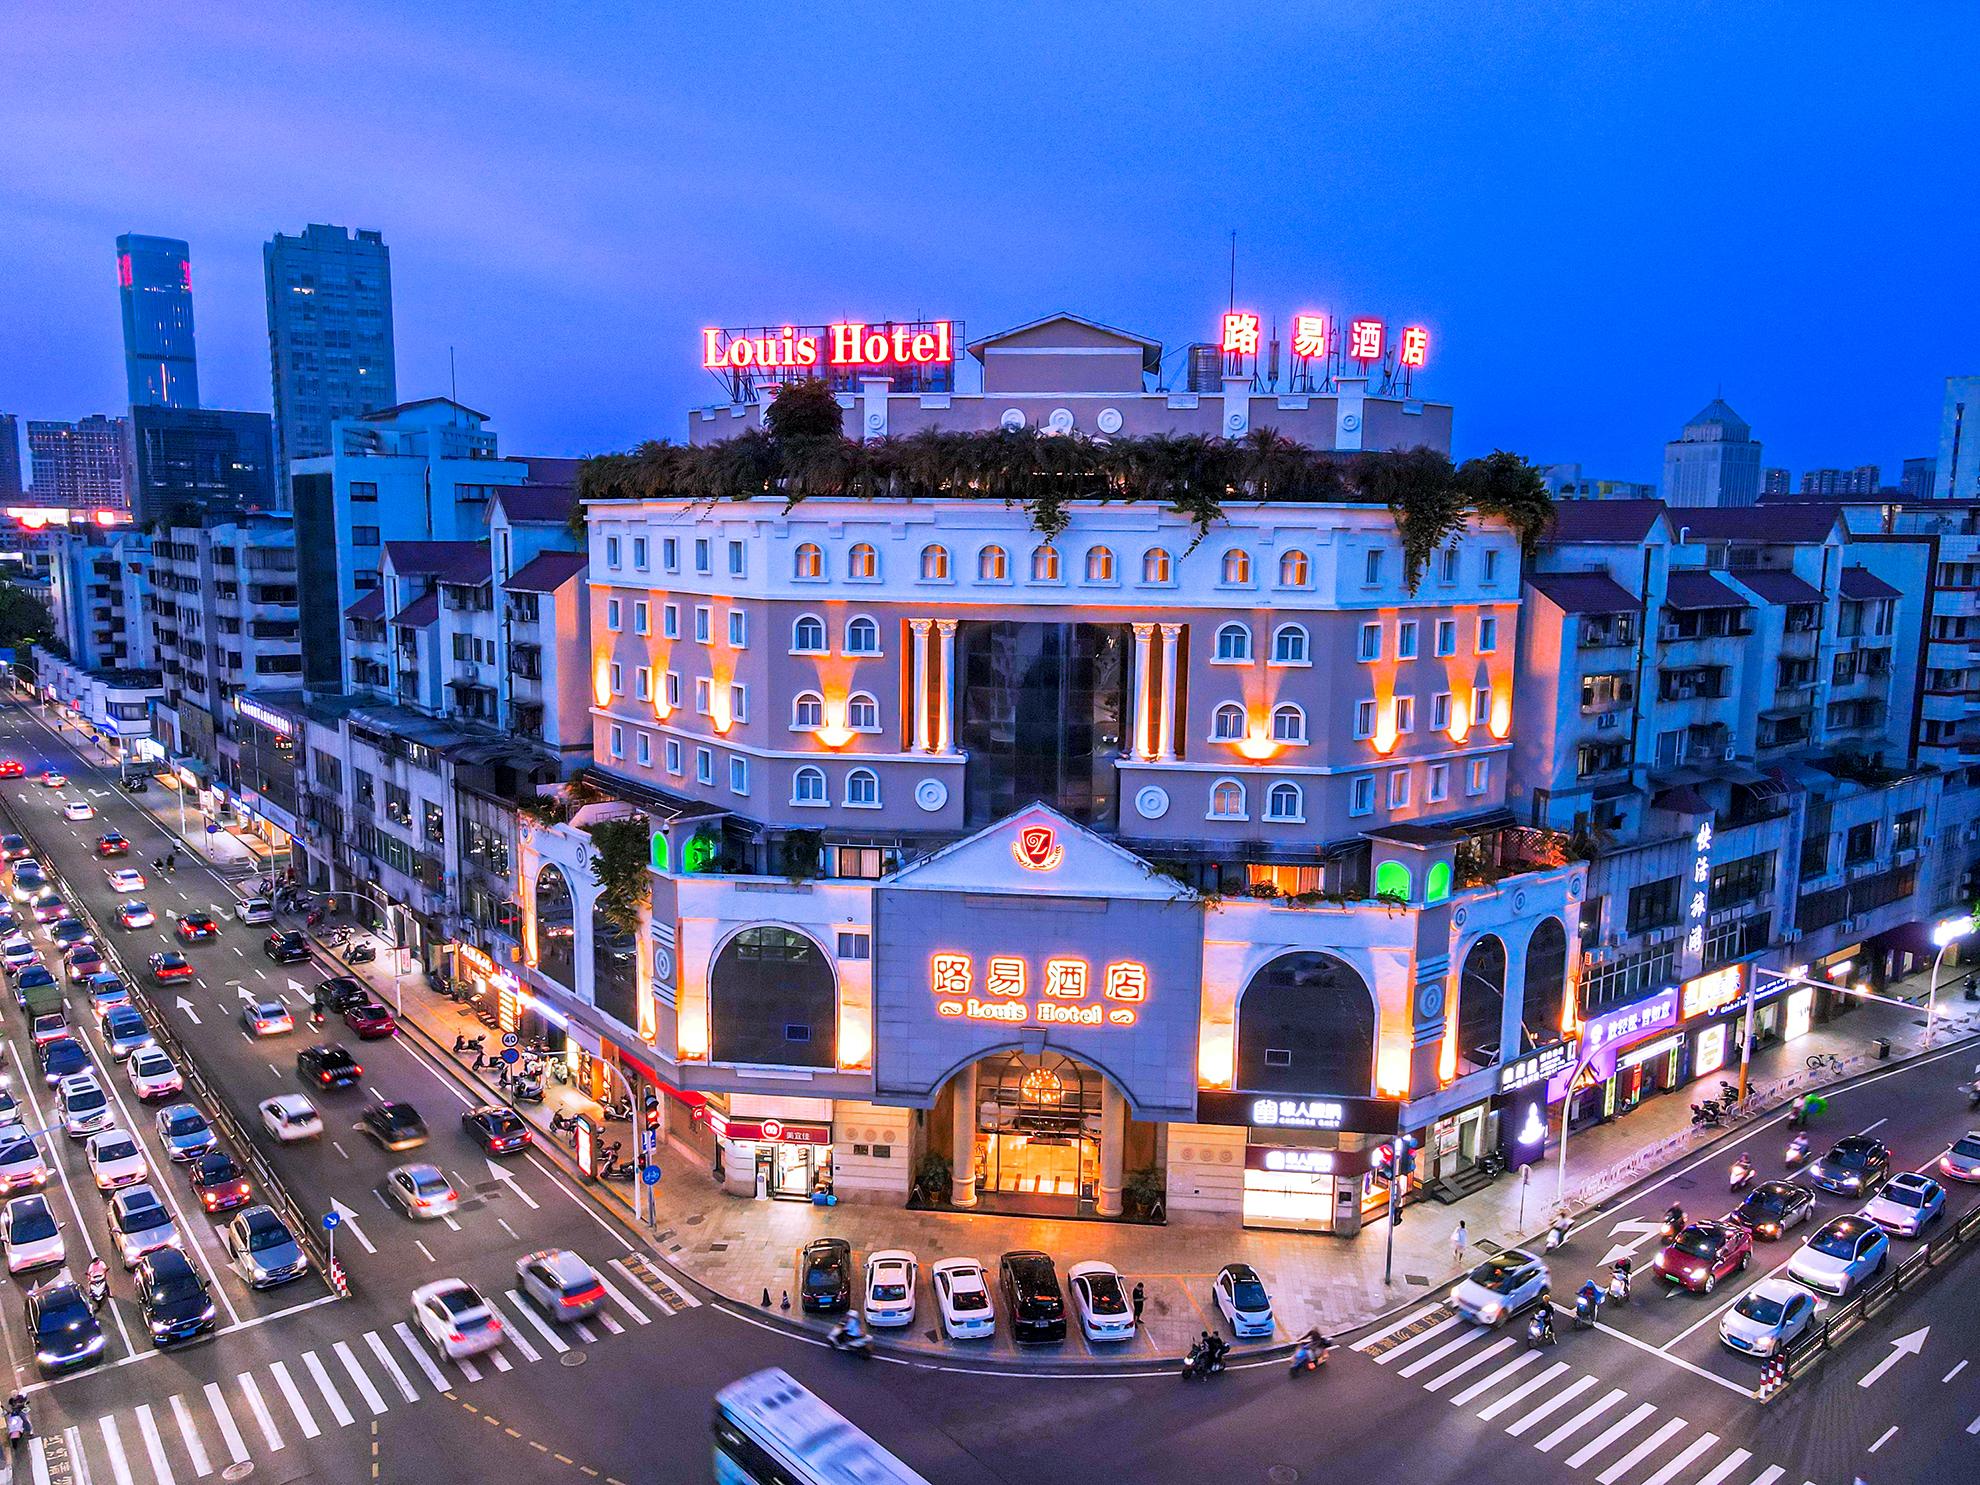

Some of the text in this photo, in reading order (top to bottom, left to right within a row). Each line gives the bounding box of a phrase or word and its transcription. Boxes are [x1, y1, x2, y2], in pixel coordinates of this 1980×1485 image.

[703, 321, 951, 367] Louis Hotel
[1222, 313, 1428, 366] 路易酒店
[934, 957, 1144, 1001] 路易酒店
[968, 1000, 1102, 1023] Louis Hotel
[504, 1034, 516, 1044] 40
